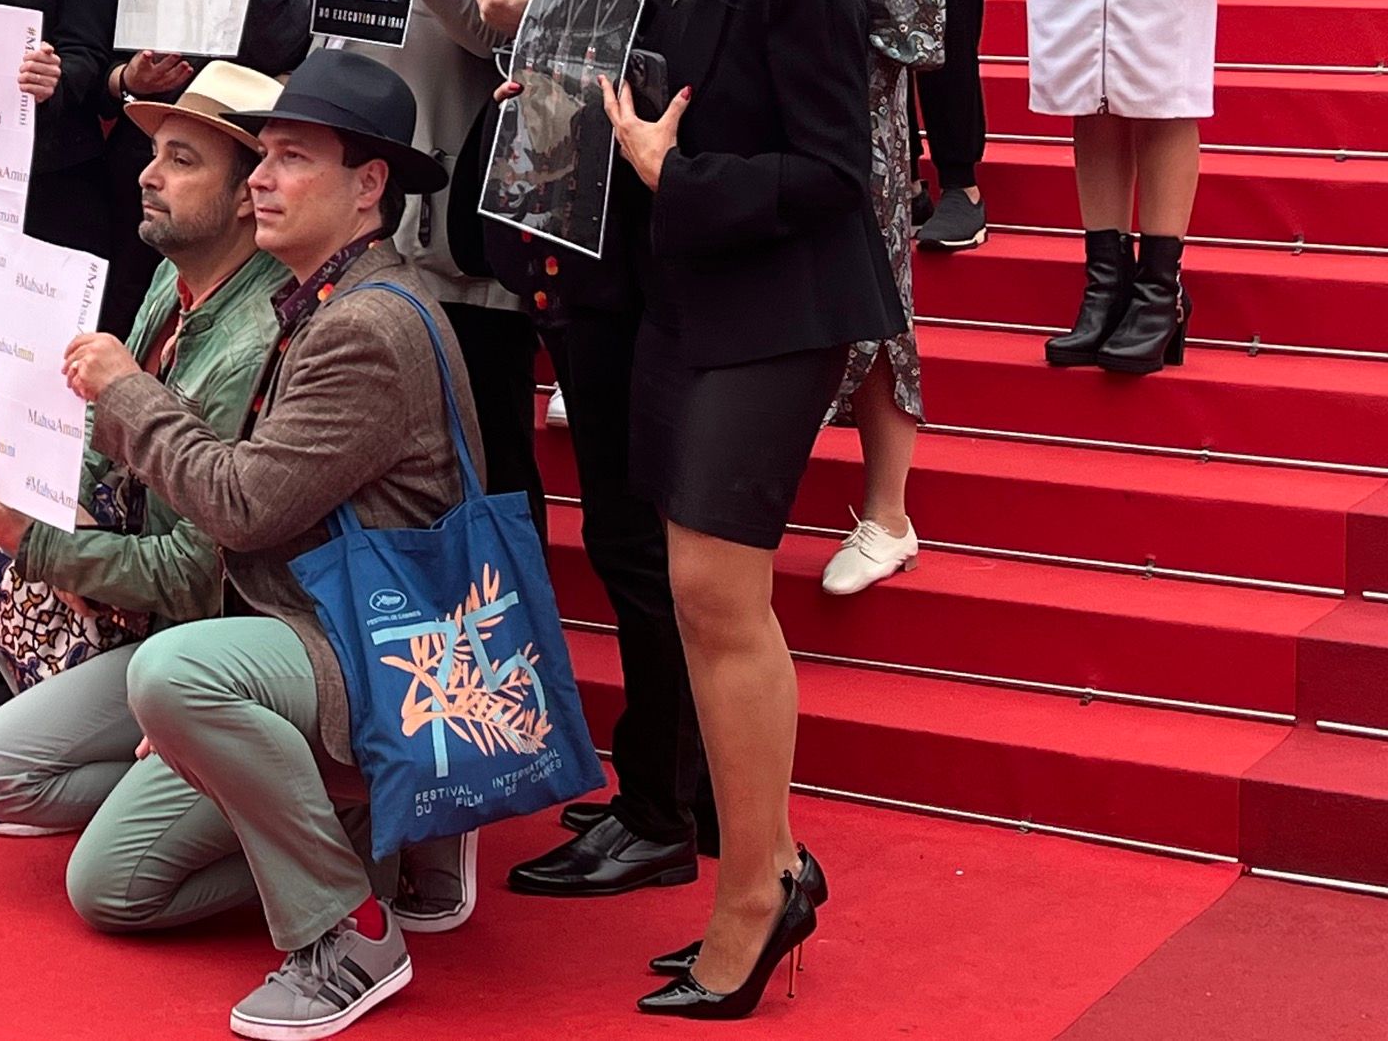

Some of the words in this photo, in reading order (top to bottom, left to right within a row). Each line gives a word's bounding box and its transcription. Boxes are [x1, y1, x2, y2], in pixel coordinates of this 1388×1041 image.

[318, 7, 330, 18] NO
[332, 9, 376, 26] EXECUTION
[415, 784, 473, 804] FESTIVAL
[415, 803, 433, 817] DU
[455, 794, 484, 808] FILM
[504, 783, 517, 797] DE
